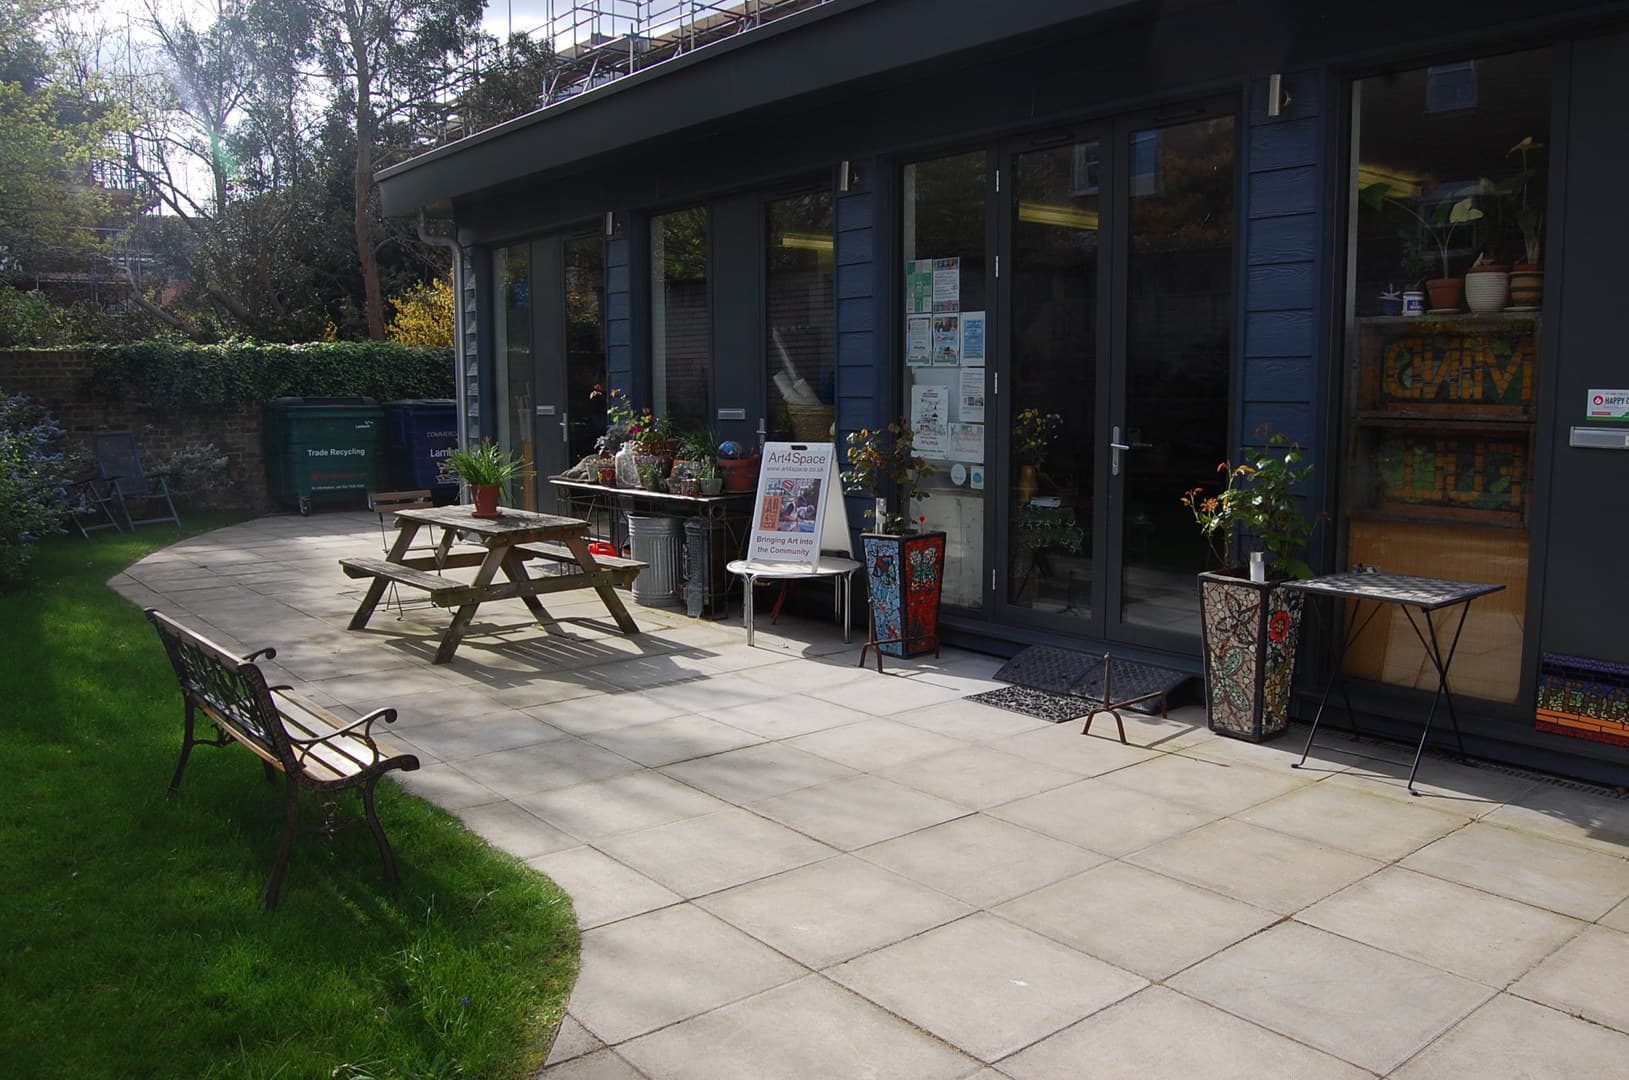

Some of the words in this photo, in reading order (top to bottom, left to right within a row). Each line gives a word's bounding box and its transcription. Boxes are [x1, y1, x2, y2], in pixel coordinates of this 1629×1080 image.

[1604, 396, 1625, 405] HAPPY
[307, 449, 329, 457] Trade
[330, 447, 366, 457] Recycling
[767, 452, 826, 466] Art4Space
[756, 535, 786, 546] Bringing
[787, 537, 799, 545] Art
[757, 546, 769, 554] the
[769, 546, 810, 557] Community
